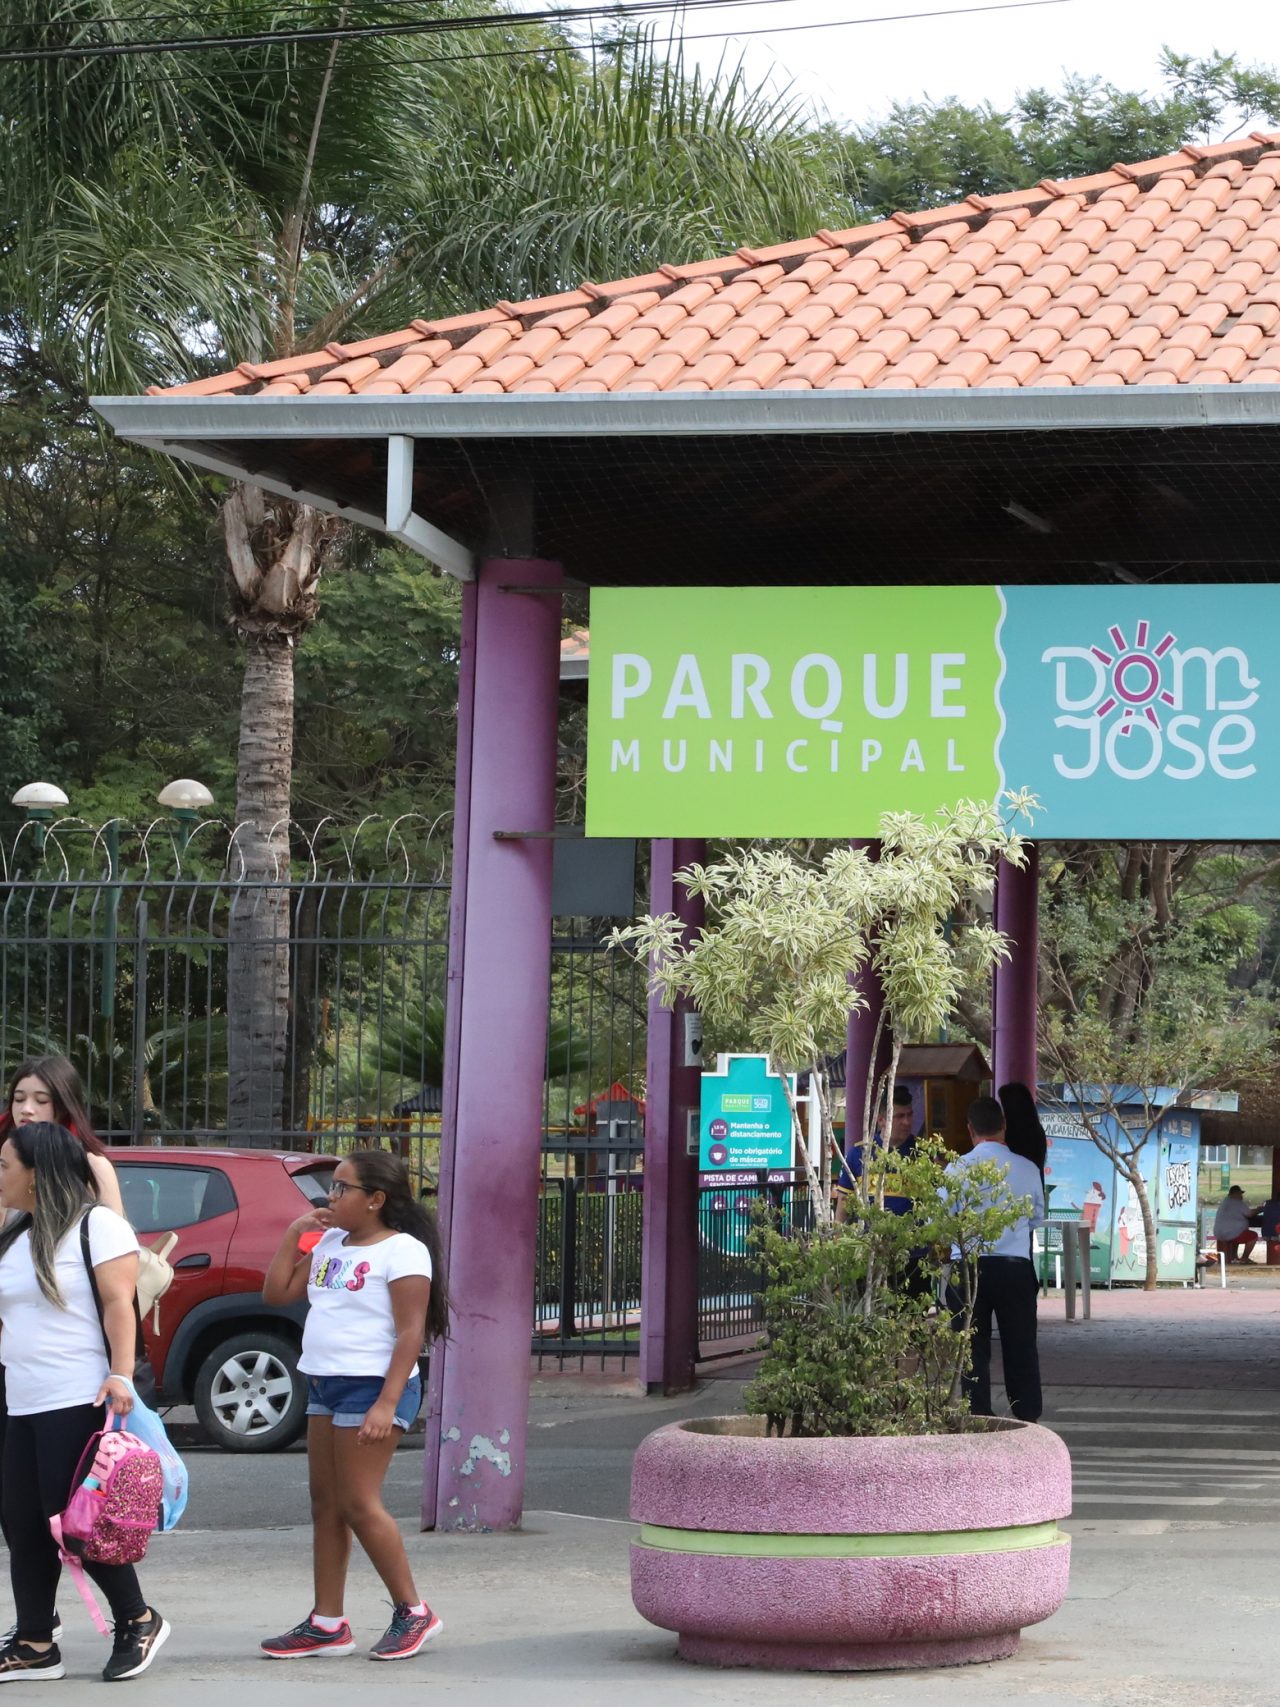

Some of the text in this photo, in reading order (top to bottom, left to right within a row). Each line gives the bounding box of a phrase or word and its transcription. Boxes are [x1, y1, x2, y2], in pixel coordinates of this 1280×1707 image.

[611, 652, 966, 733] PARQUE
[610, 739, 965, 773] MUNICIPAL
[744, 1147, 783, 1156] obrigatório
[704, 1174, 724, 1182] PISTA
